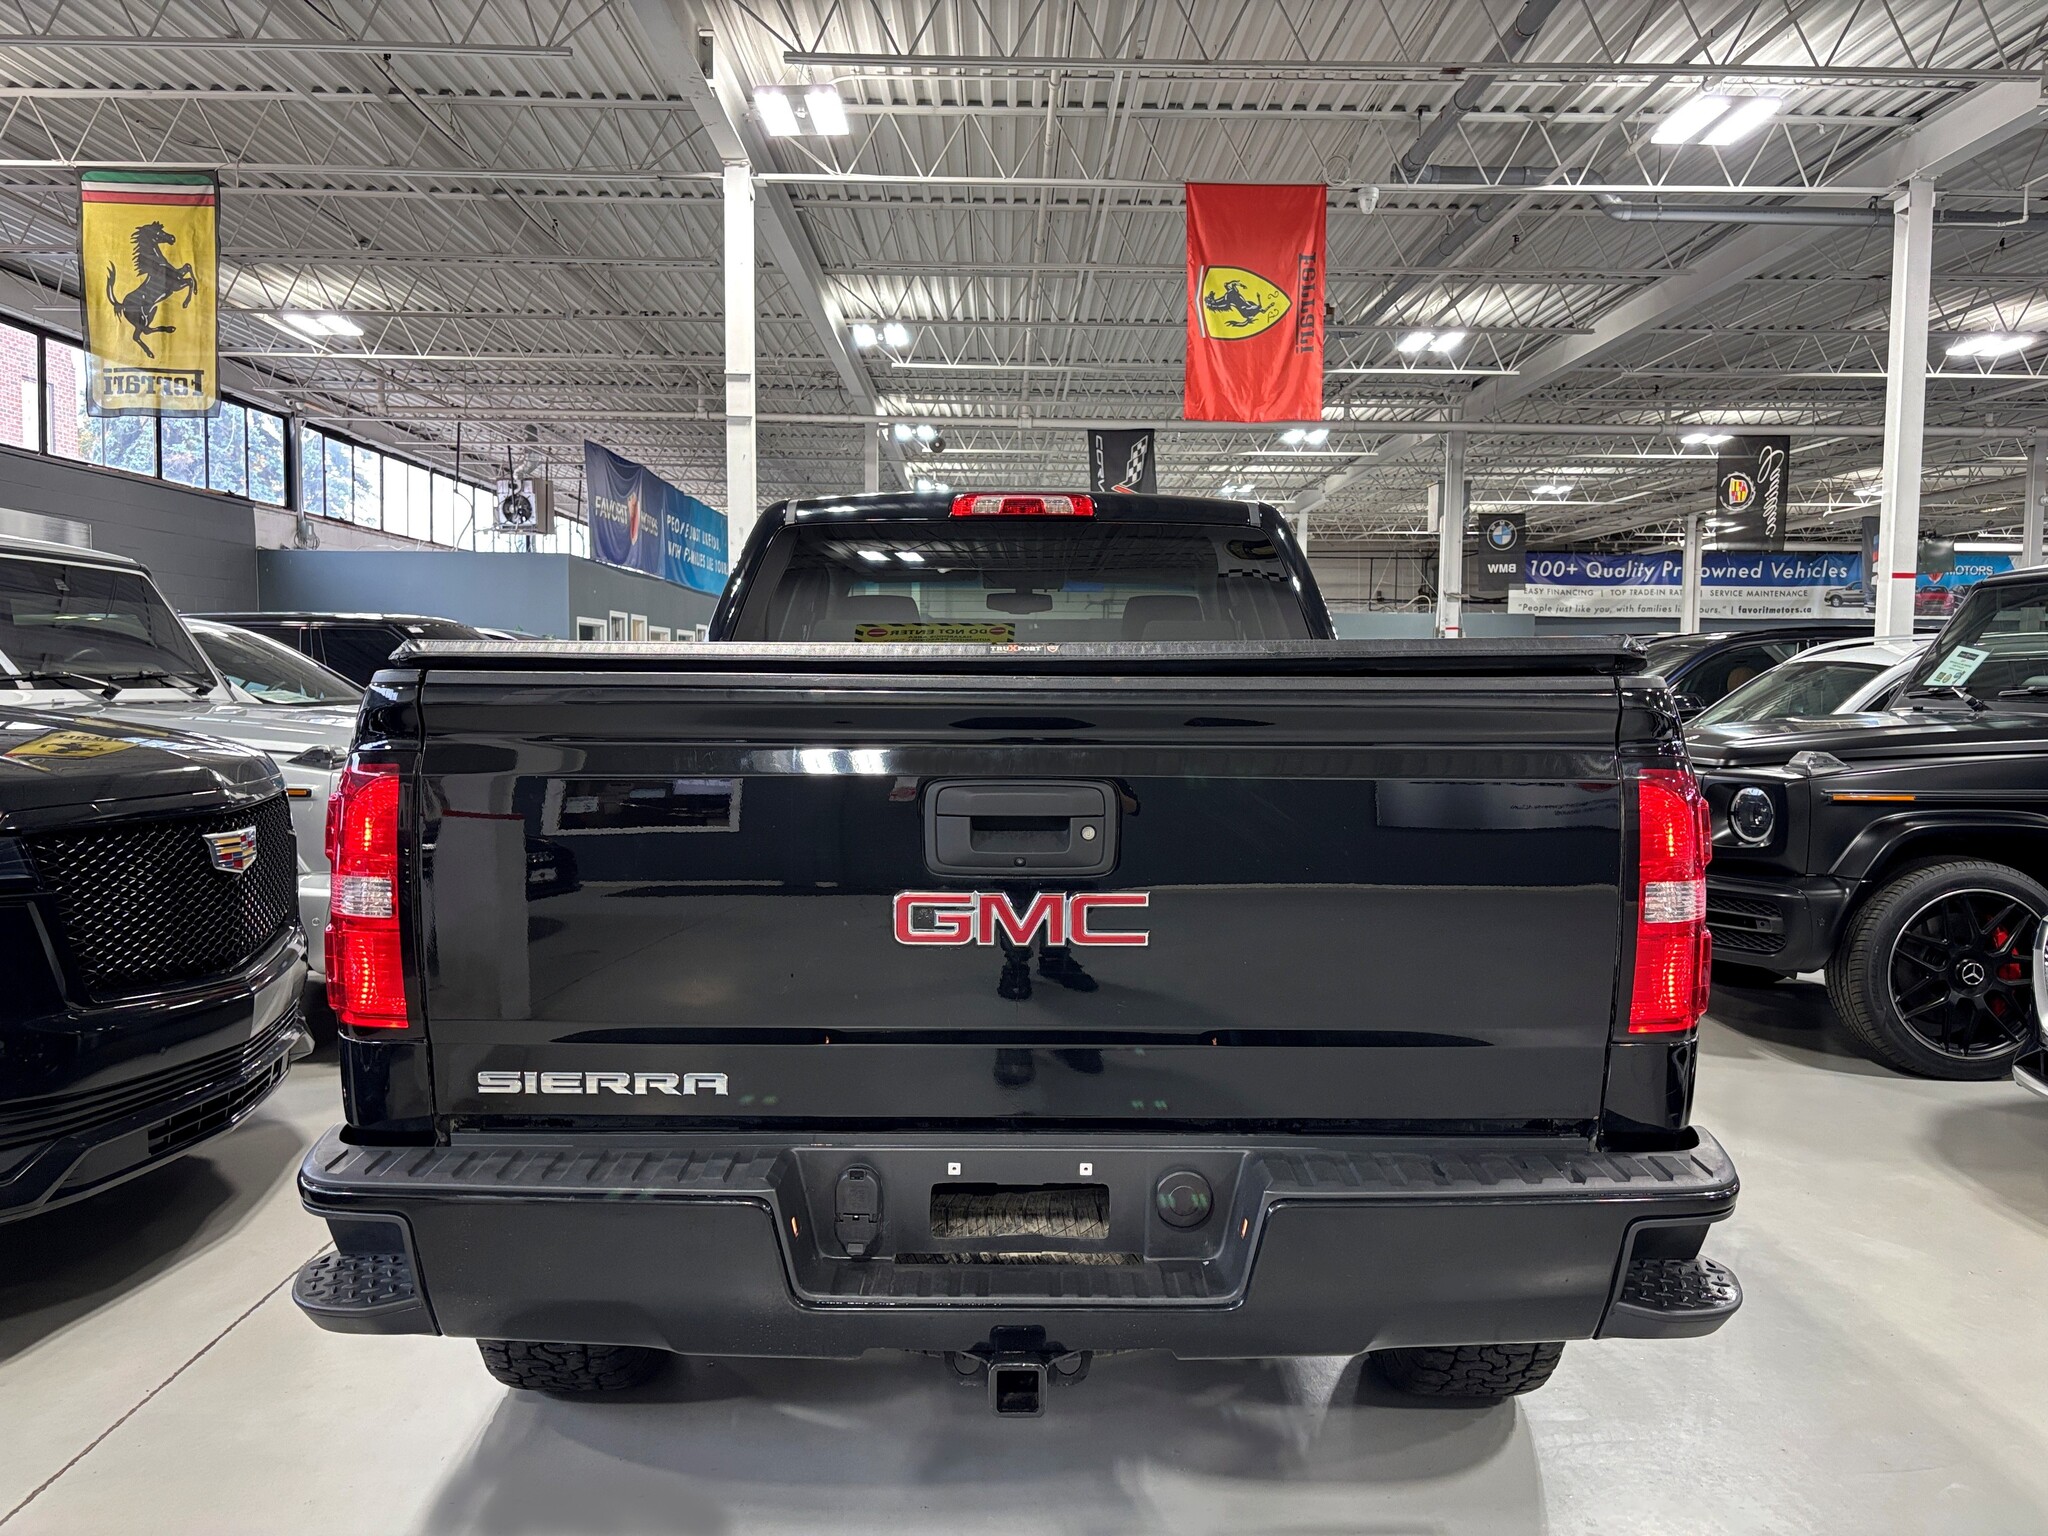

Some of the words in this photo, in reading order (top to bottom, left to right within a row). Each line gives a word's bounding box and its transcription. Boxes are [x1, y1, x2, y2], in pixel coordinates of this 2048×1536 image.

[1095, 434, 1106, 493] CORV
[1530, 559, 1579, 578] 100+
[1586, 561, 1656, 582] Quality
[1662, 559, 1764, 579] Prowned
[1770, 560, 1848, 579] Vehicles
[1946, 564, 1995, 576] OTORS
[1523, 587, 1544, 596] EASY
[1547, 588, 1594, 596] FINANCING
[1610, 589, 1627, 597] TOP
[1629, 588, 1666, 597] TRADE-IN
[1669, 588, 1683, 597] RAT
[1709, 589, 1743, 597] SERVICE
[1746, 589, 1809, 598] MAINTENANCE
[1554, 603, 1573, 614] just
[1575, 603, 1592, 613] like
[1593, 606, 1613, 615] you,
[1616, 604, 1635, 613] with
[1637, 603, 1673, 614] families
[1738, 605, 1812, 614] favoritmotors.ca
[893, 890, 1150, 947] GMC
[477, 1071, 729, 1096] SIERRA
